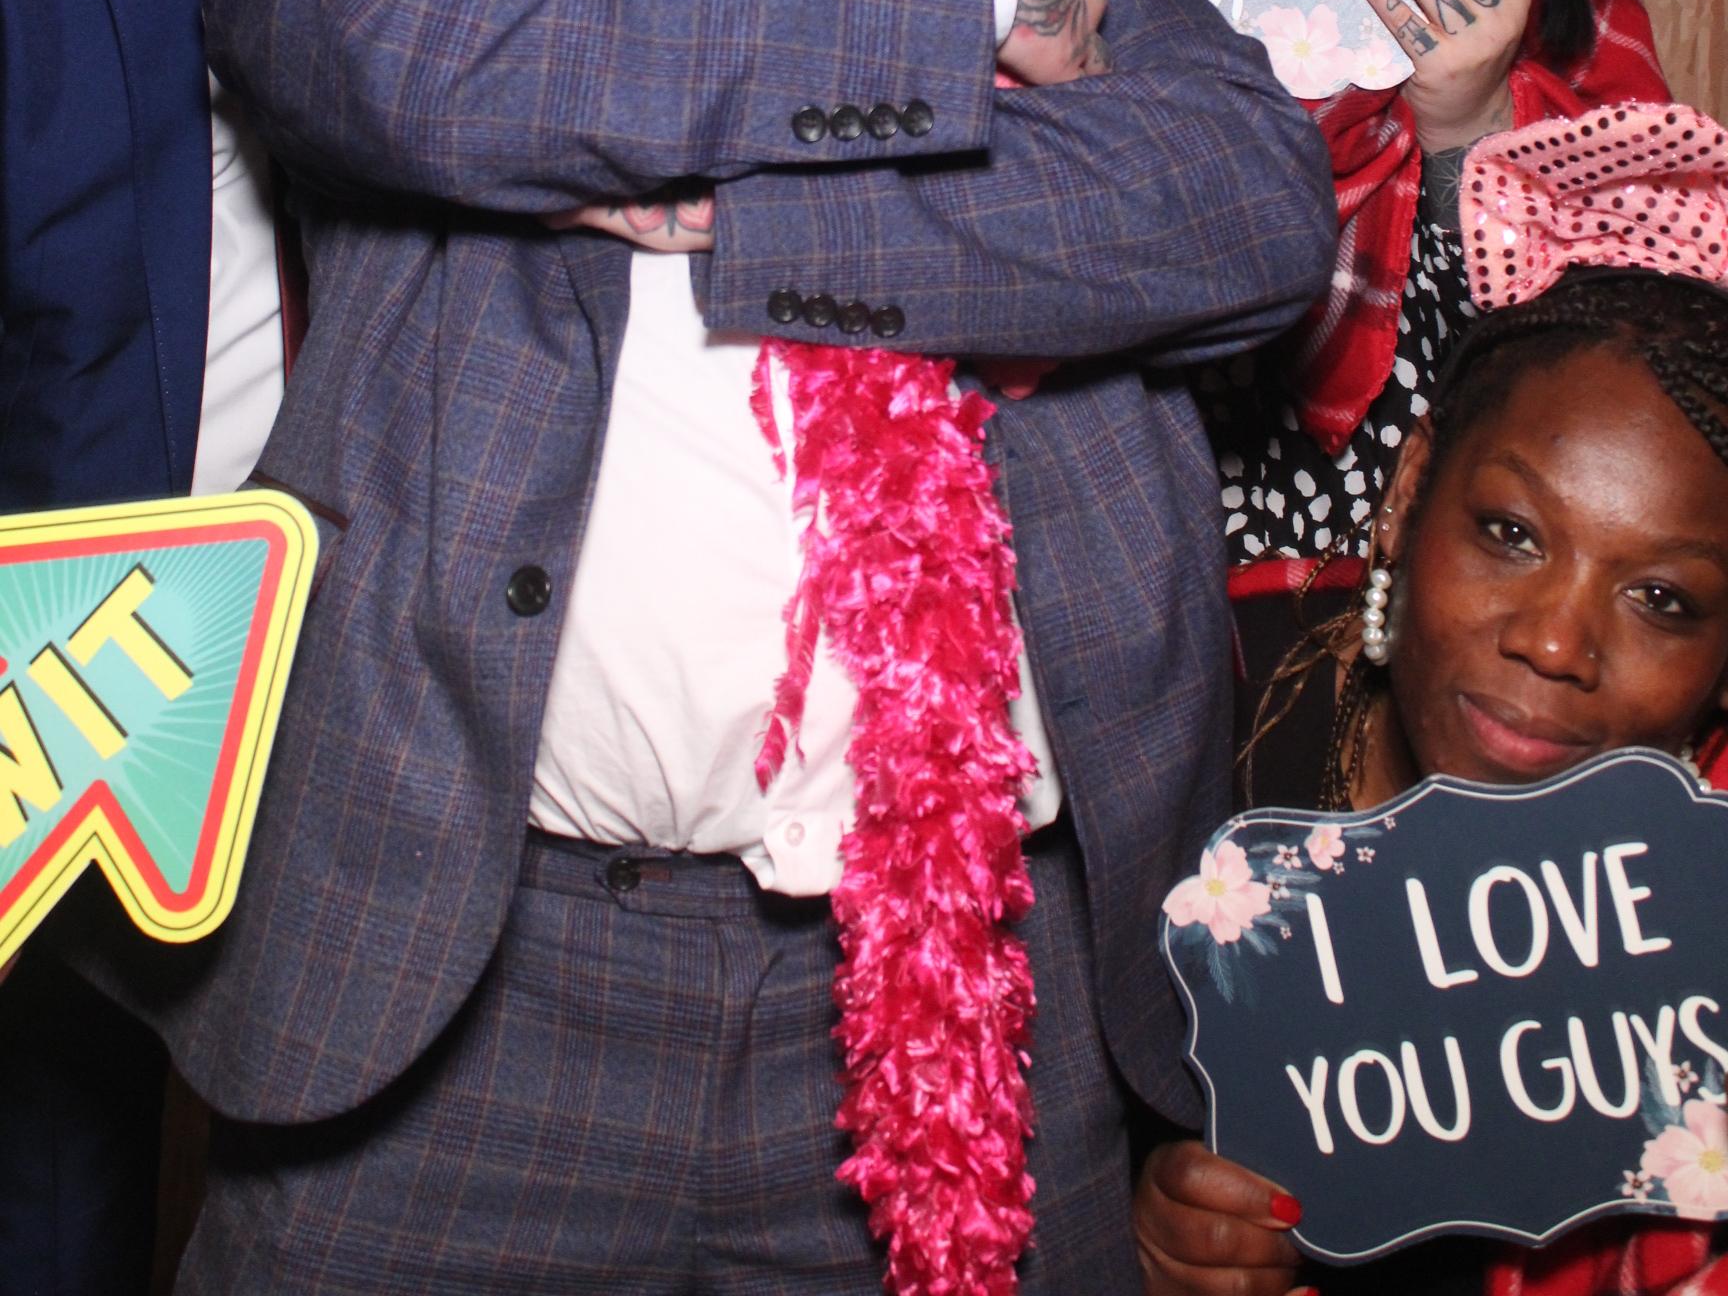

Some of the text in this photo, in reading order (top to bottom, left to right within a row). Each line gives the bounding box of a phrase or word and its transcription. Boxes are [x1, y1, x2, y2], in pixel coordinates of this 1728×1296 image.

[1306, 842, 1673, 1004] I LOVE
[1285, 994, 1728, 1154] YOU GUYS
